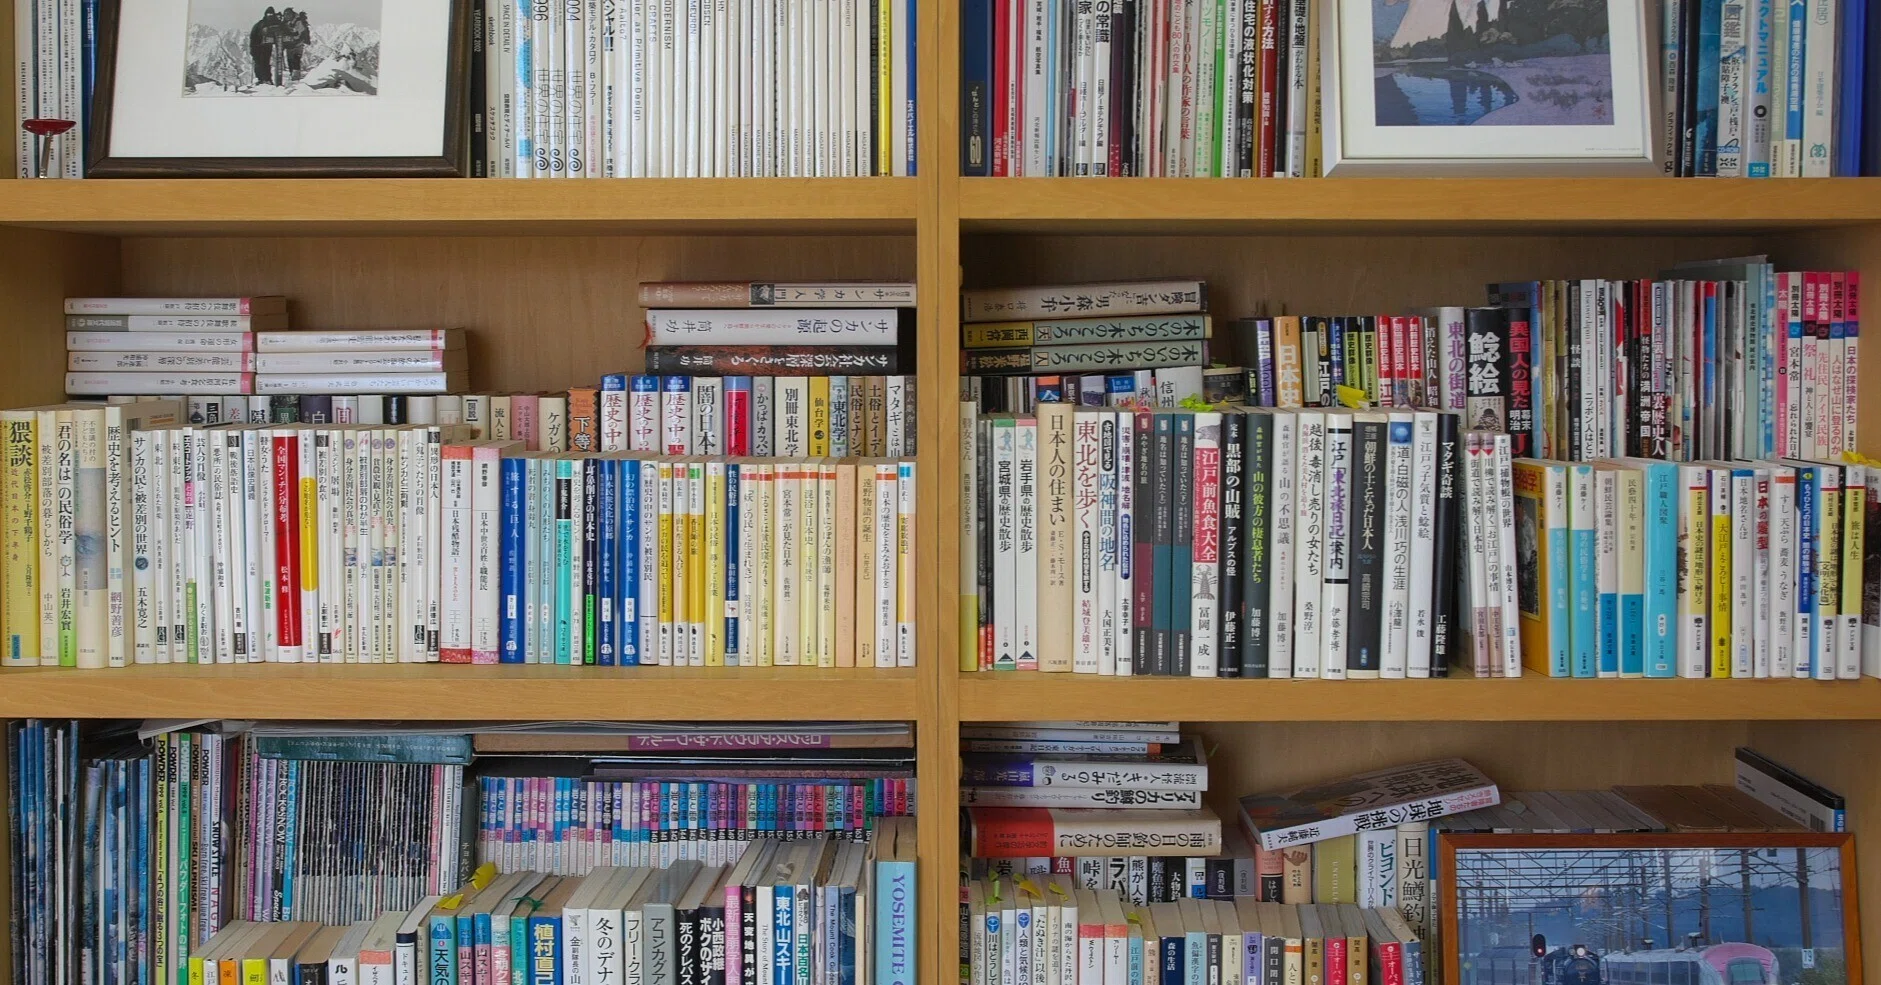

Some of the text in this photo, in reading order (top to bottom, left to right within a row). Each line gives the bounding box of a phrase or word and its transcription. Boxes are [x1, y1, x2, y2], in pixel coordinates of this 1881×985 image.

[10, 421, 34, 468] 猥談
[632, 394, 656, 451] 歴史の中の
[697, 386, 716, 457] 闇の日本
[1076, 421, 1098, 529] 東北を歩く
[1224, 443, 1242, 520] 黒部の山賊
[892, 874, 906, 974] YOSEMITE
